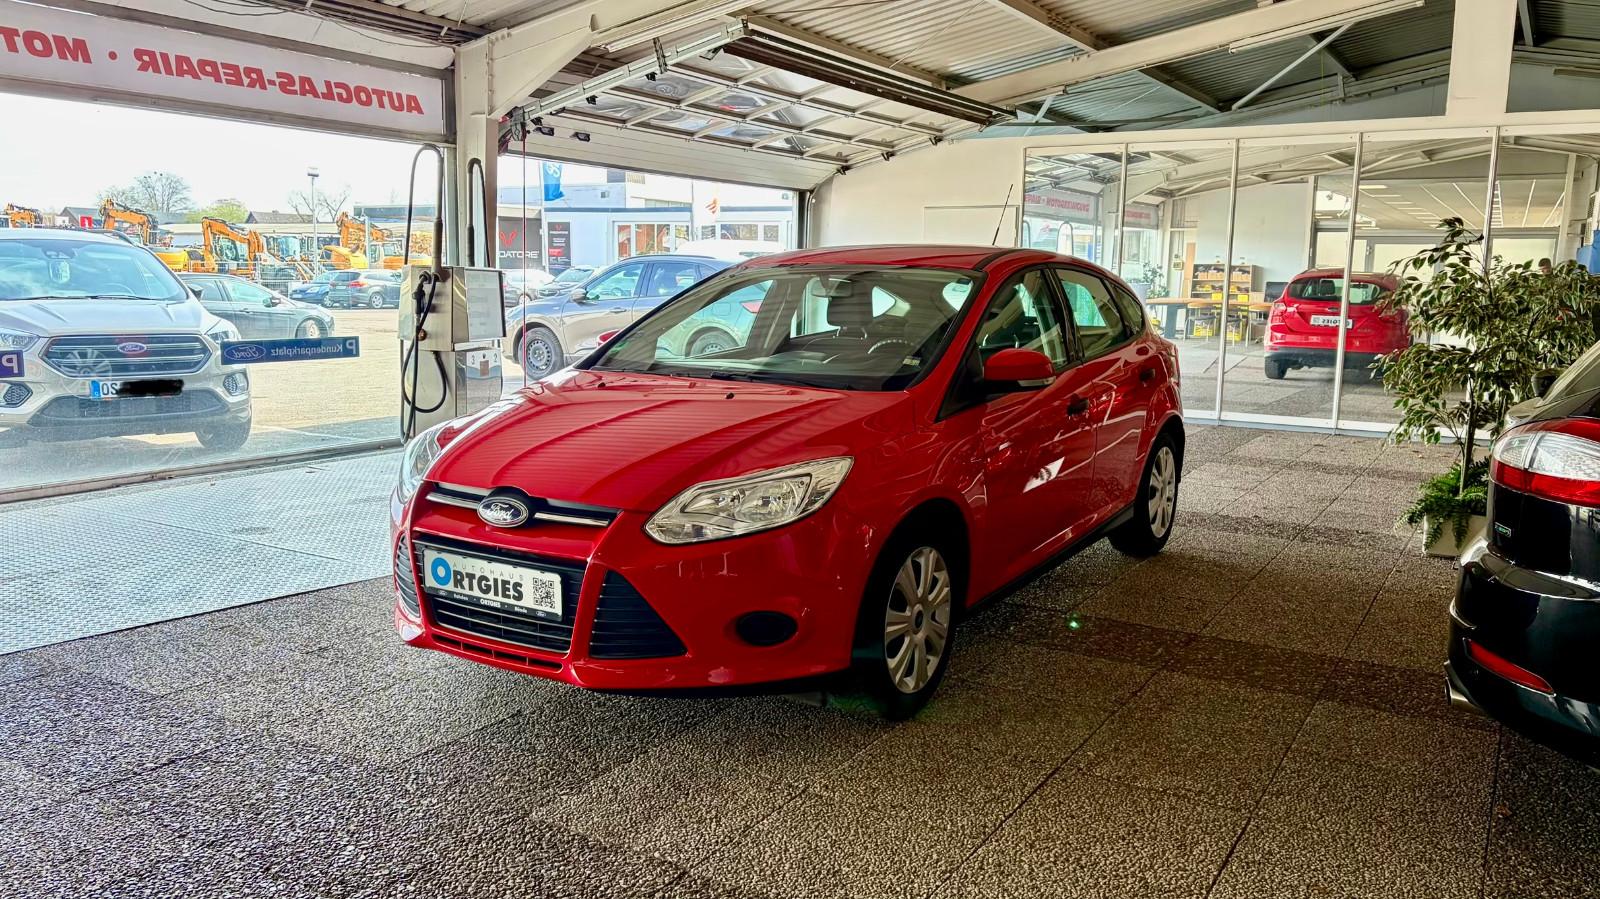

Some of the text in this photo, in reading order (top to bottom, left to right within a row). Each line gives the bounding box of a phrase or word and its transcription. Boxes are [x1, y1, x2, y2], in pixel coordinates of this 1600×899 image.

[486, 502, 515, 521] Ford
[430, 557, 524, 602] ORTGIES
[452, 560, 524, 581] AUTOHAUS
[480, 598, 501, 608] ORTGIES
